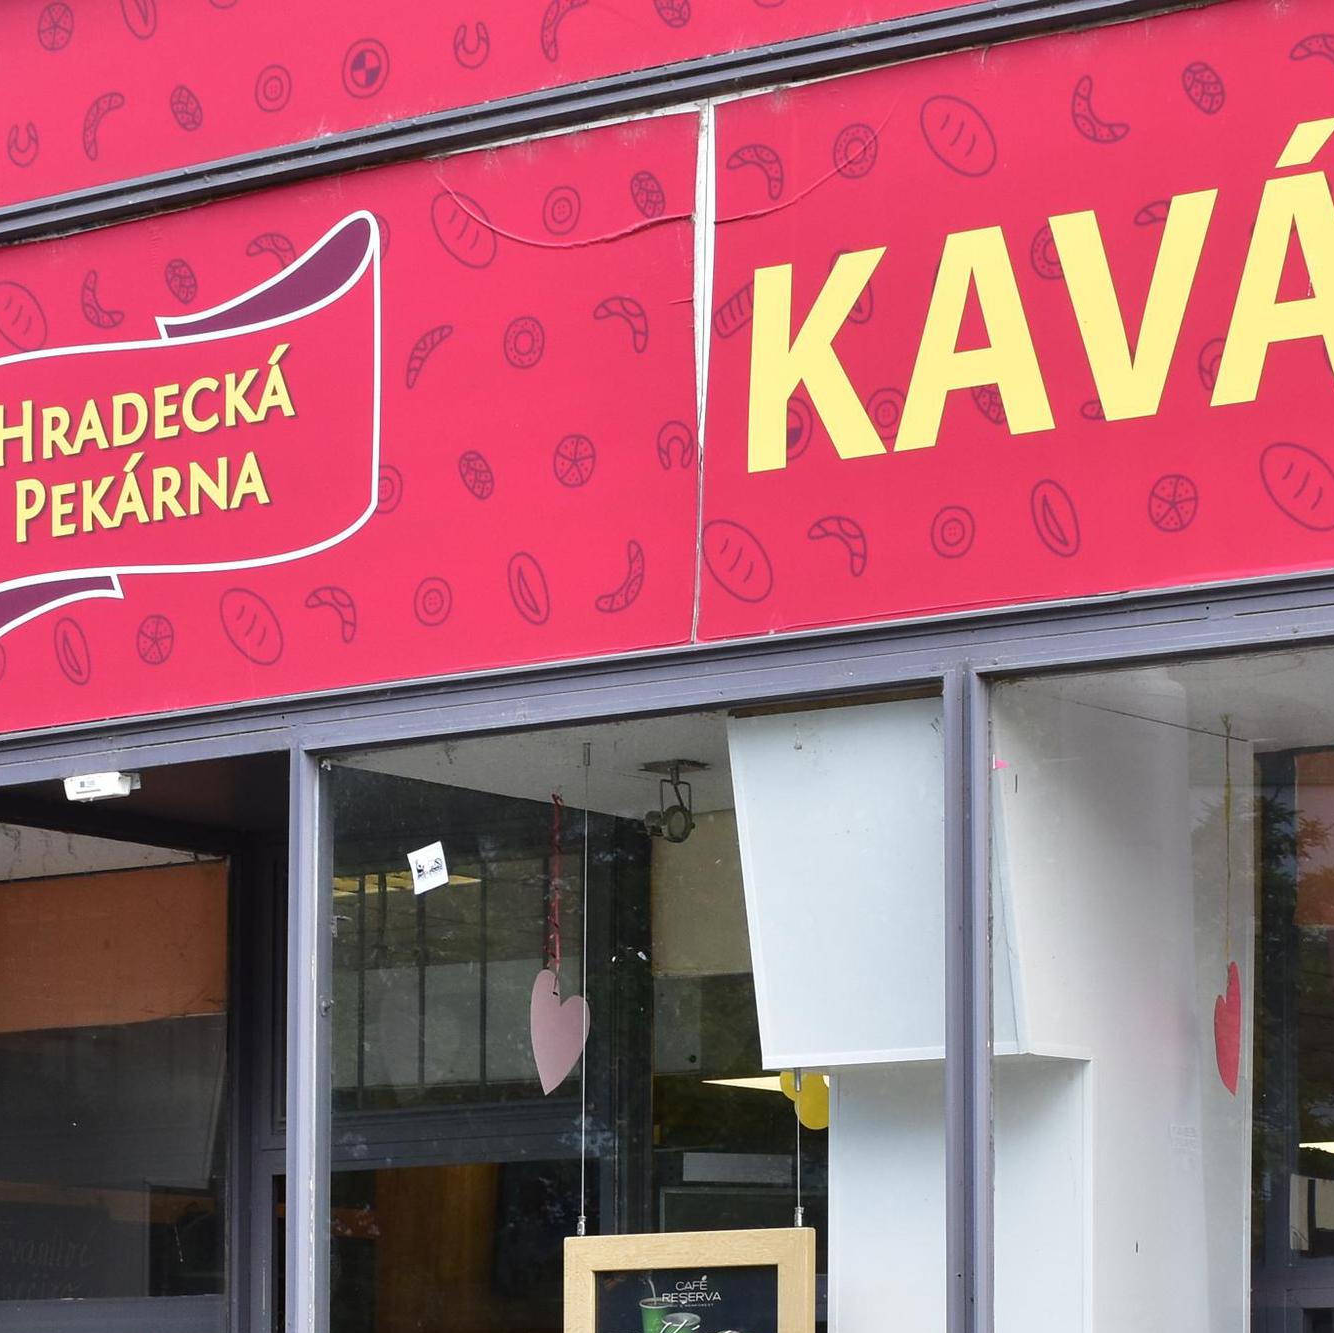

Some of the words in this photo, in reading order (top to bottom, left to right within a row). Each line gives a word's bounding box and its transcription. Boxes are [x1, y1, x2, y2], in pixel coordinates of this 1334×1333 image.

[15, 451, 271, 543] PEKÁRNA
[675, 1275, 708, 1291] CAFÉ
[662, 1291, 722, 1303] RESERVA
